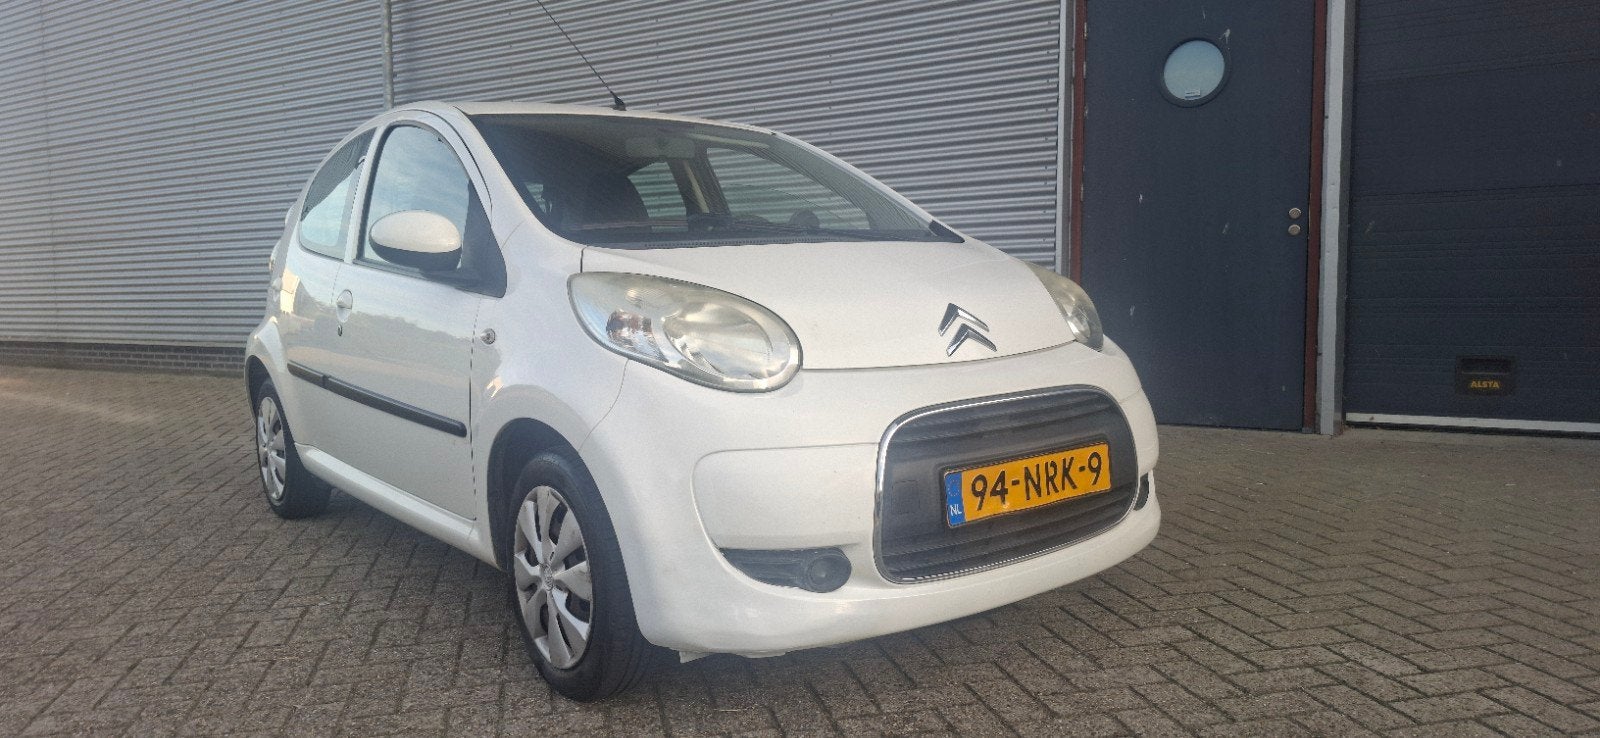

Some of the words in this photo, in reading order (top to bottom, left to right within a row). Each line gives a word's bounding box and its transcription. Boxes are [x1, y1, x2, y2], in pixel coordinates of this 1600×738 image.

[1470, 380, 1500, 388] ALSTA
[971, 451, 1102, 511] 94-NRK-9
[950, 504, 962, 516] NL
